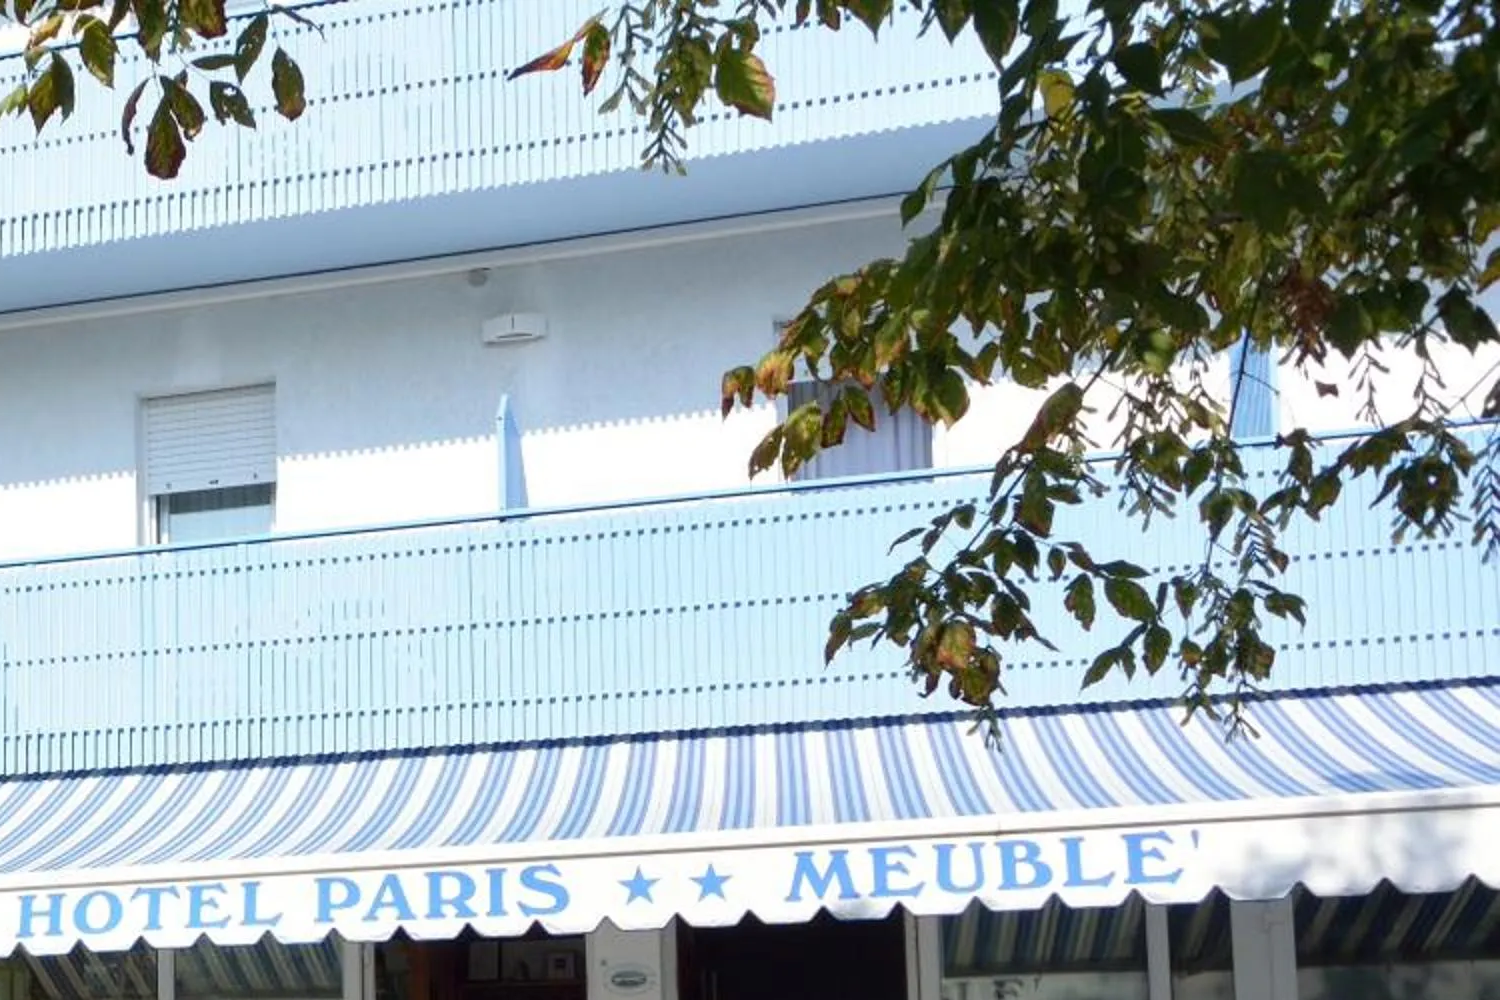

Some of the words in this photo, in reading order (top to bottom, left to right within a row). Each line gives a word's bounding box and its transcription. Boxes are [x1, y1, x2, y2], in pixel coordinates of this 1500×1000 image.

[15, 881, 284, 938] HOTEL
[314, 863, 571, 922] PARIS
[785, 829, 1200, 902] MEUBLE'
